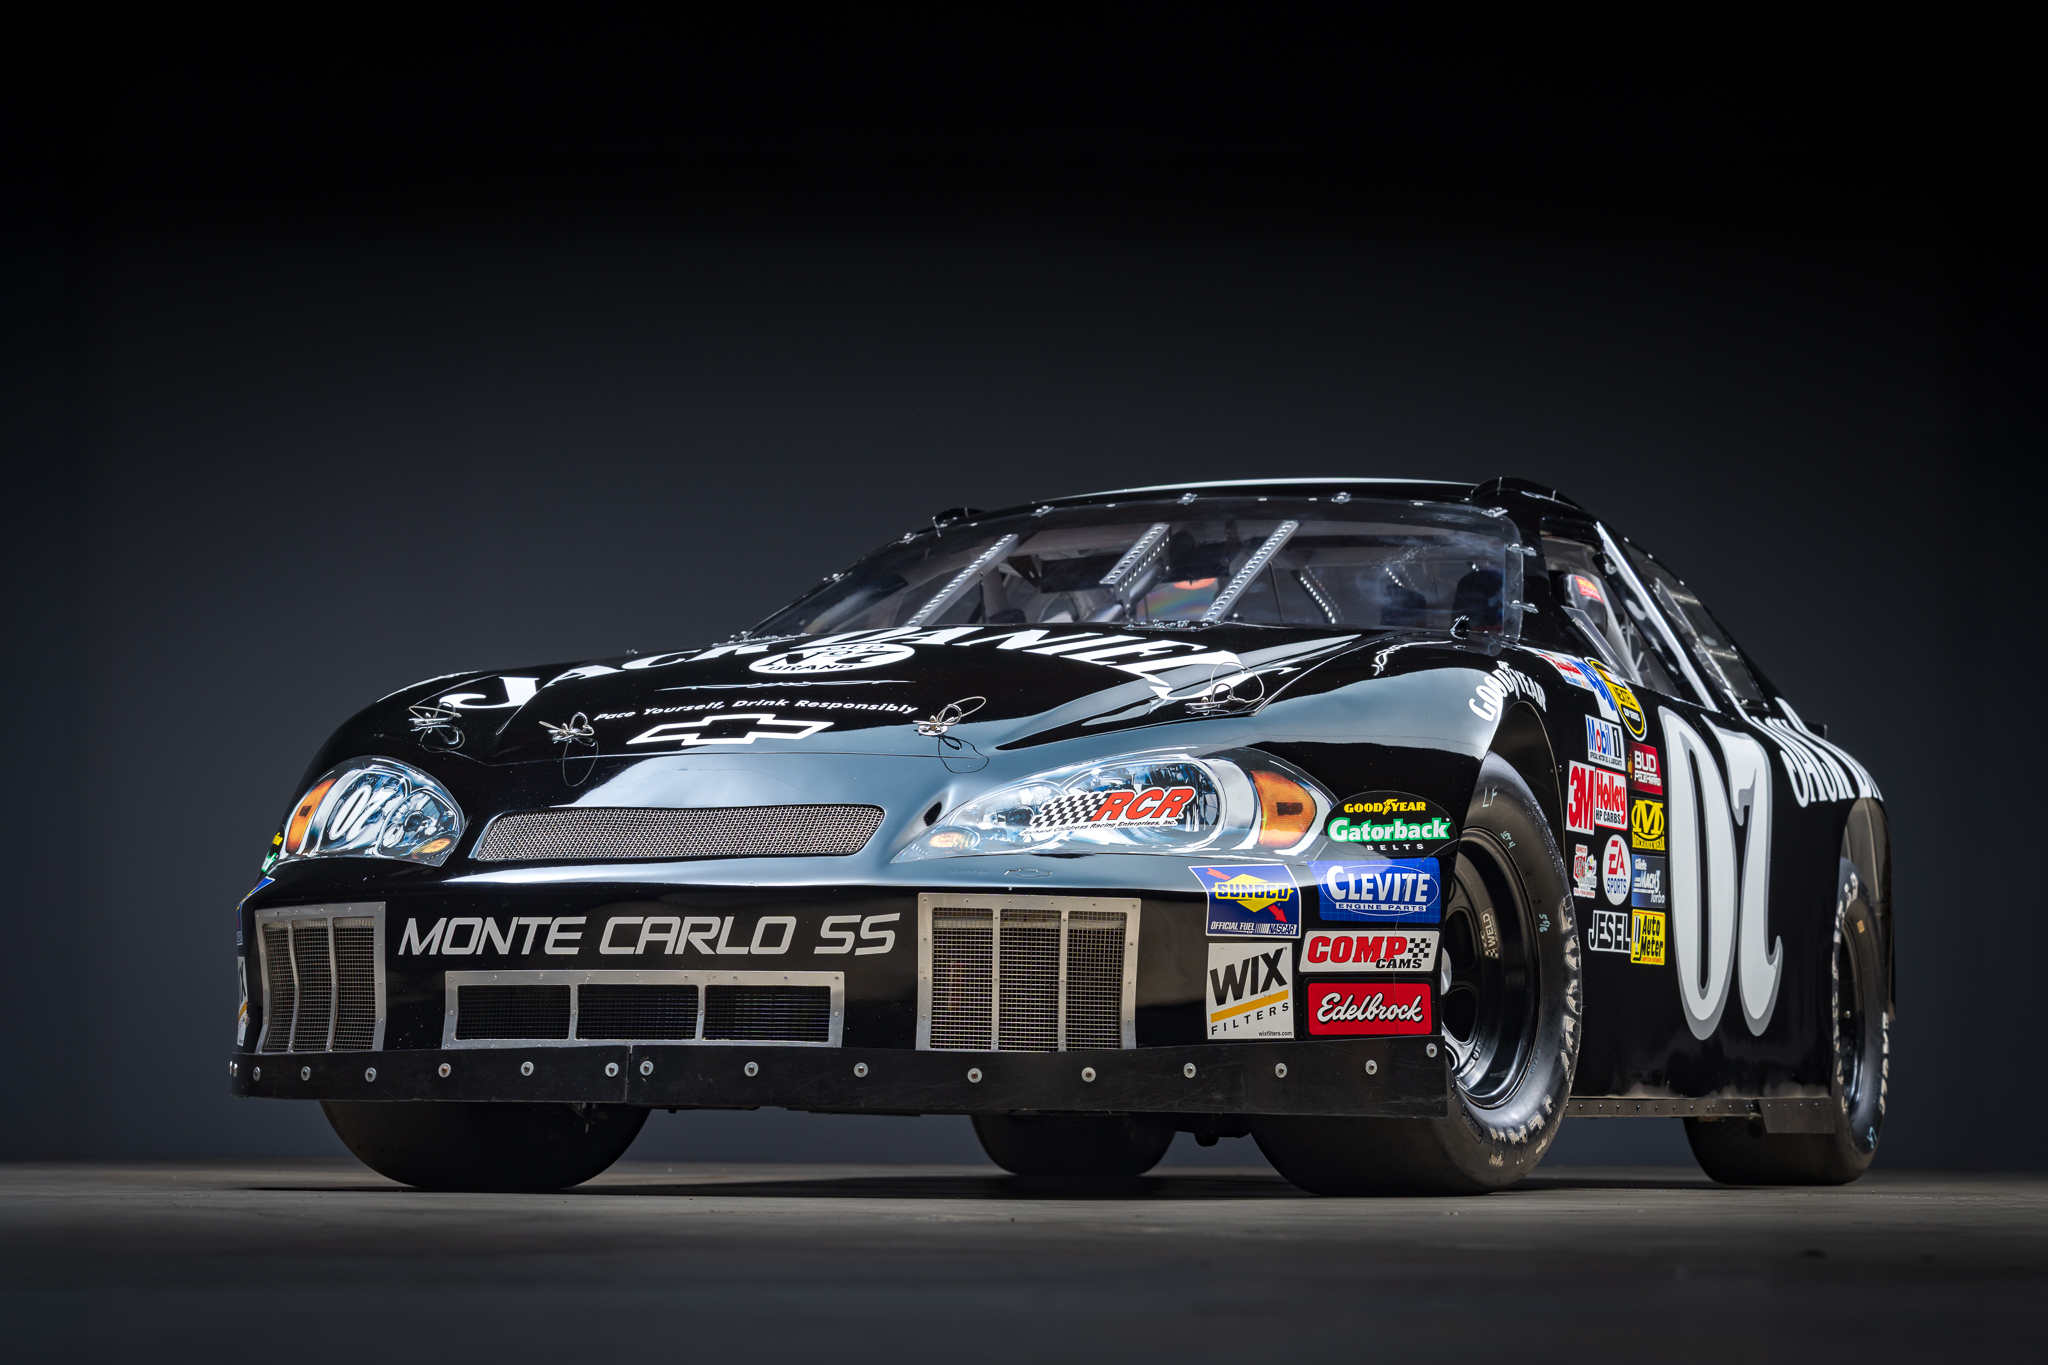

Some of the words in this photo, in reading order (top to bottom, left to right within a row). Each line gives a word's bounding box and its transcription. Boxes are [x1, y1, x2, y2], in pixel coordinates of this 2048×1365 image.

[1469, 660, 1547, 721] GOODYEAR
[594, 711, 636, 721] Pace
[643, 700, 725, 716] Yourself,
[732, 699, 790, 708] Drink
[794, 700, 919, 714] Responsibly
[1587, 717, 1612, 757] Mobil
[1634, 750, 1657, 773] BUD
[1091, 789, 1194, 821] RCR
[1344, 798, 1427, 815] GOODYEAR
[1568, 765, 1594, 831] 3M
[1596, 771, 1626, 825] Holley
[1328, 817, 1451, 843] Gatorback
[1596, 809, 1603, 821] HP
[1603, 811, 1621, 825] CARBS
[1366, 843, 1424, 851] BELTS
[1608, 840, 1626, 876] EA
[1327, 865, 1430, 902] CLEVITE
[1606, 877, 1627, 895] SPORTS
[1658, 704, 1784, 1041] 07
[1215, 882, 1291, 900] SUNOCO
[1388, 904, 1425, 912] PARTS
[398, 916, 587, 956] MONTE
[599, 915, 797, 955] CARLO
[813, 912, 901, 956] SS
[1210, 921, 1238, 930] OFFICIAL
[1240, 922, 1255, 931] FUEL
[1268, 923, 1297, 934] NASCAR
[1482, 913, 1496, 948] WELD
[1588, 909, 1632, 954] JESEL
[1642, 915, 1661, 937] Auto
[1307, 935, 1408, 963] COMP
[1641, 935, 1664, 958] Meter
[1209, 947, 1288, 1007] WIX
[1375, 958, 1423, 969] CAMS
[1211, 1002, 1290, 1036] FILTERS
[1316, 992, 1423, 1023] Edelbrock
